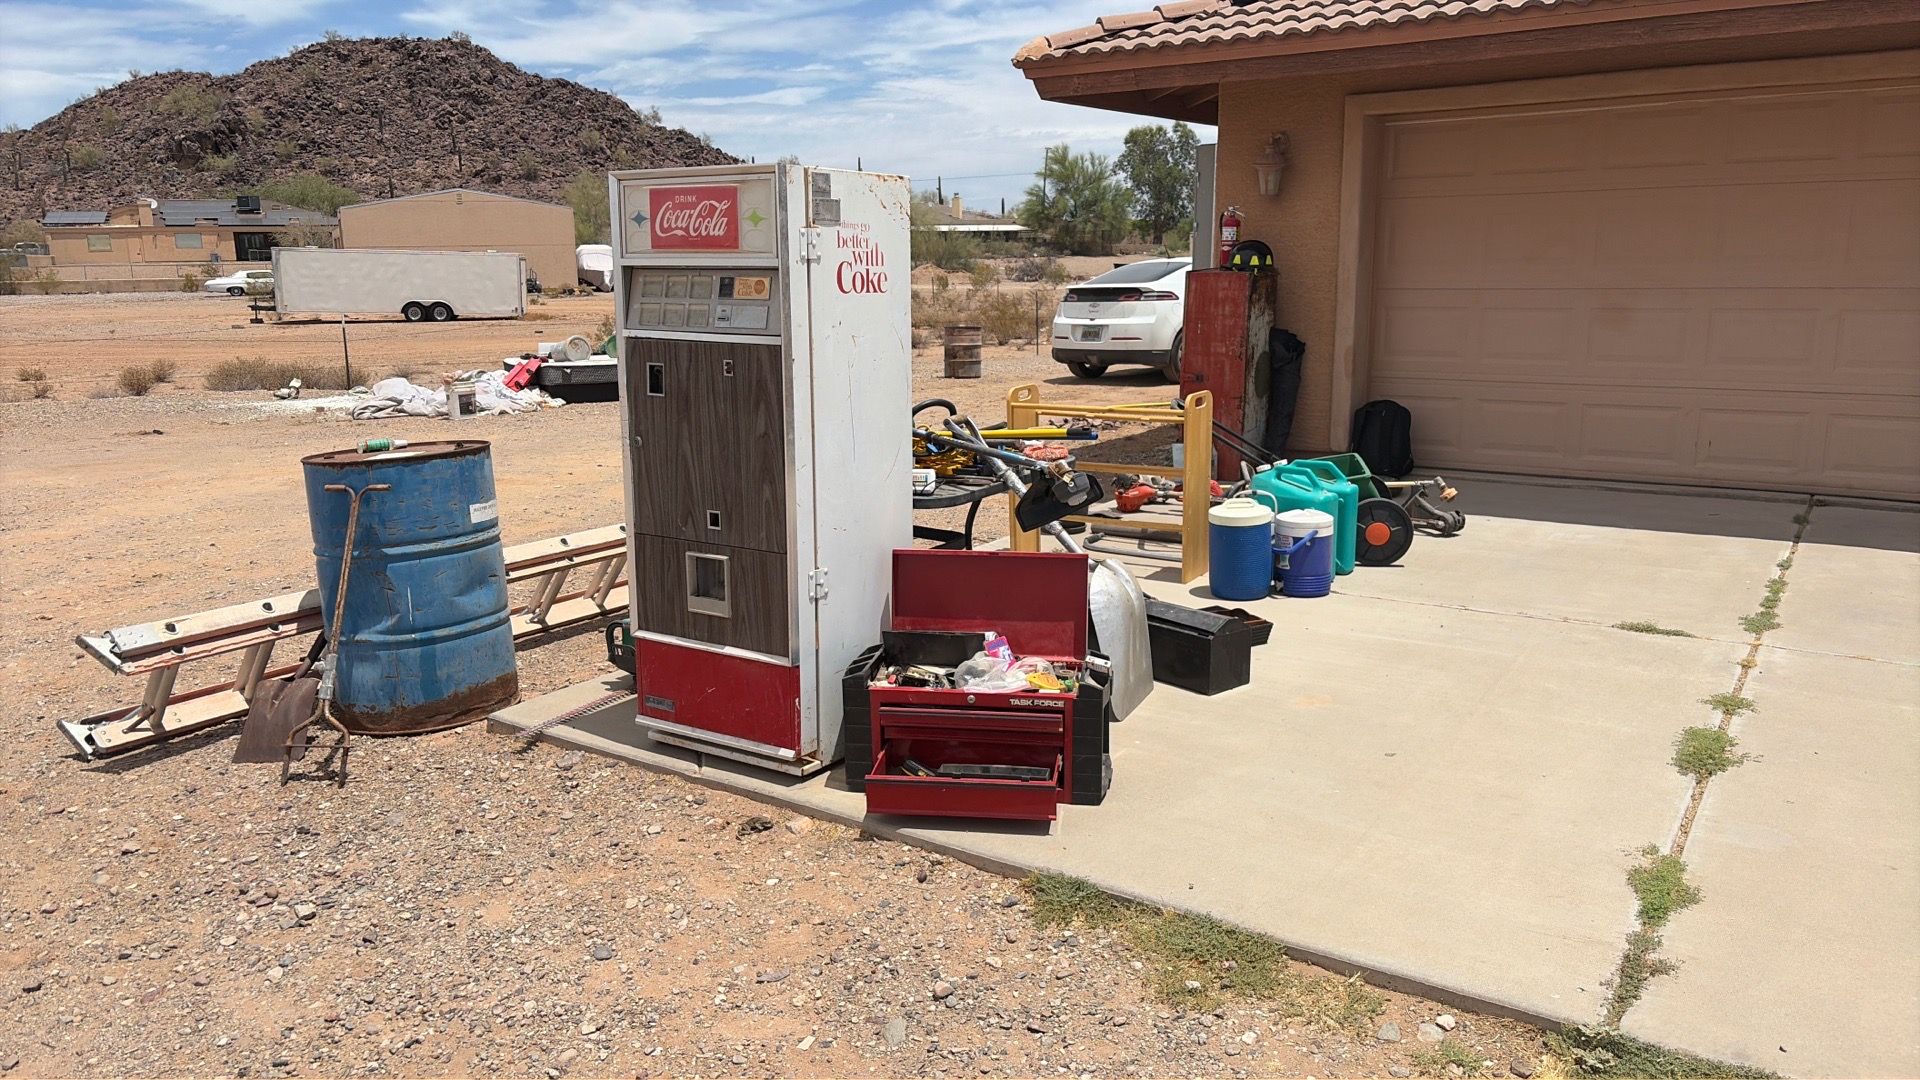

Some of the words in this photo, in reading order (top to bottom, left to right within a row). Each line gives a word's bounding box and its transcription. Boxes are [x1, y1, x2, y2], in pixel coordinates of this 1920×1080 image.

[674, 195, 697, 203] DRINK
[655, 200, 731, 237] Coca-Cola
[840, 219, 860, 230] things
[860, 223, 871, 235] go
[837, 230, 870, 249] better
[852, 242, 885, 267] with
[836, 260, 888, 294] Coke
[1009, 698, 1033, 706] TASK
[1034, 700, 1065, 708] FORCE
